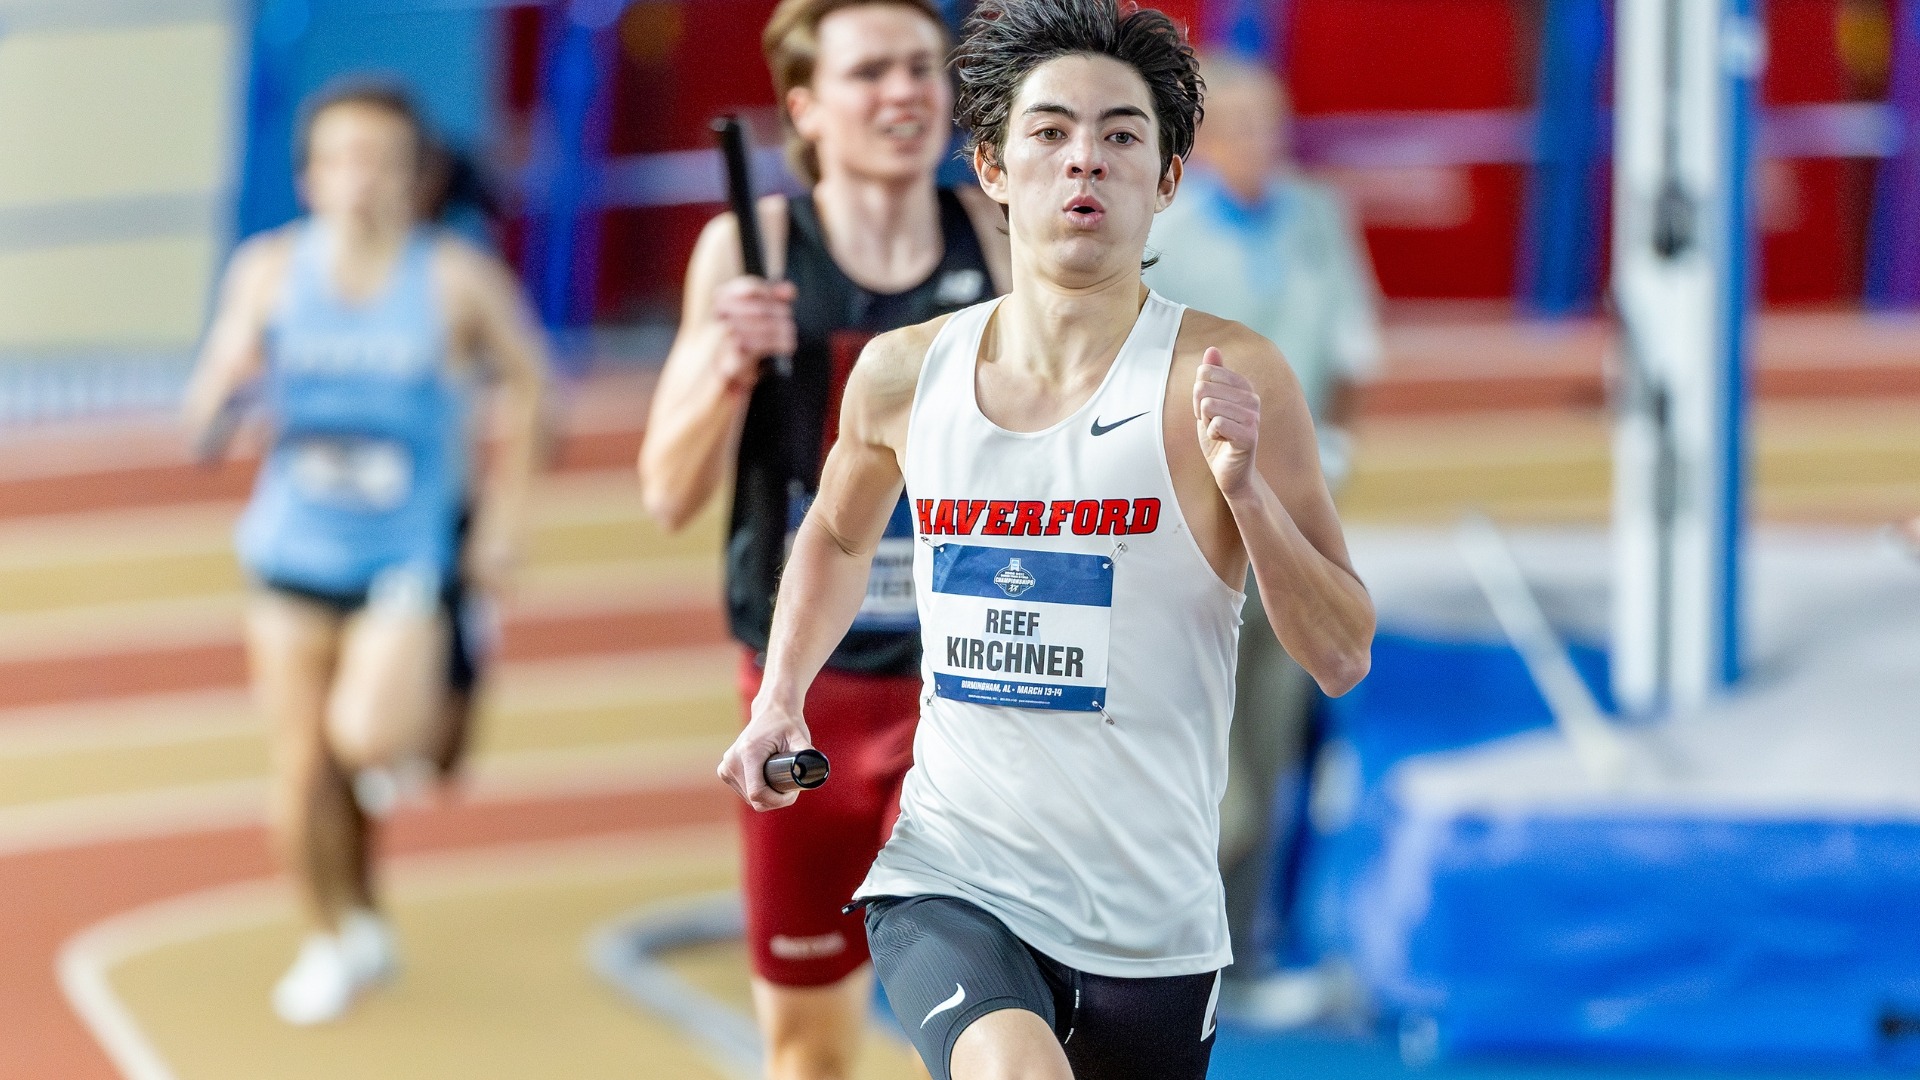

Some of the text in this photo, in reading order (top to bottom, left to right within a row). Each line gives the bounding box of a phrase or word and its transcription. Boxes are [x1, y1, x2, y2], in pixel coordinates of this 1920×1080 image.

[916, 498, 1162, 536] HAVERFORD
[985, 608, 1041, 636] REEF
[946, 636, 1084, 678] KIRCHNER
[961, 680, 1063, 697] BIRMINGHAM, AL MARCH 13-14
